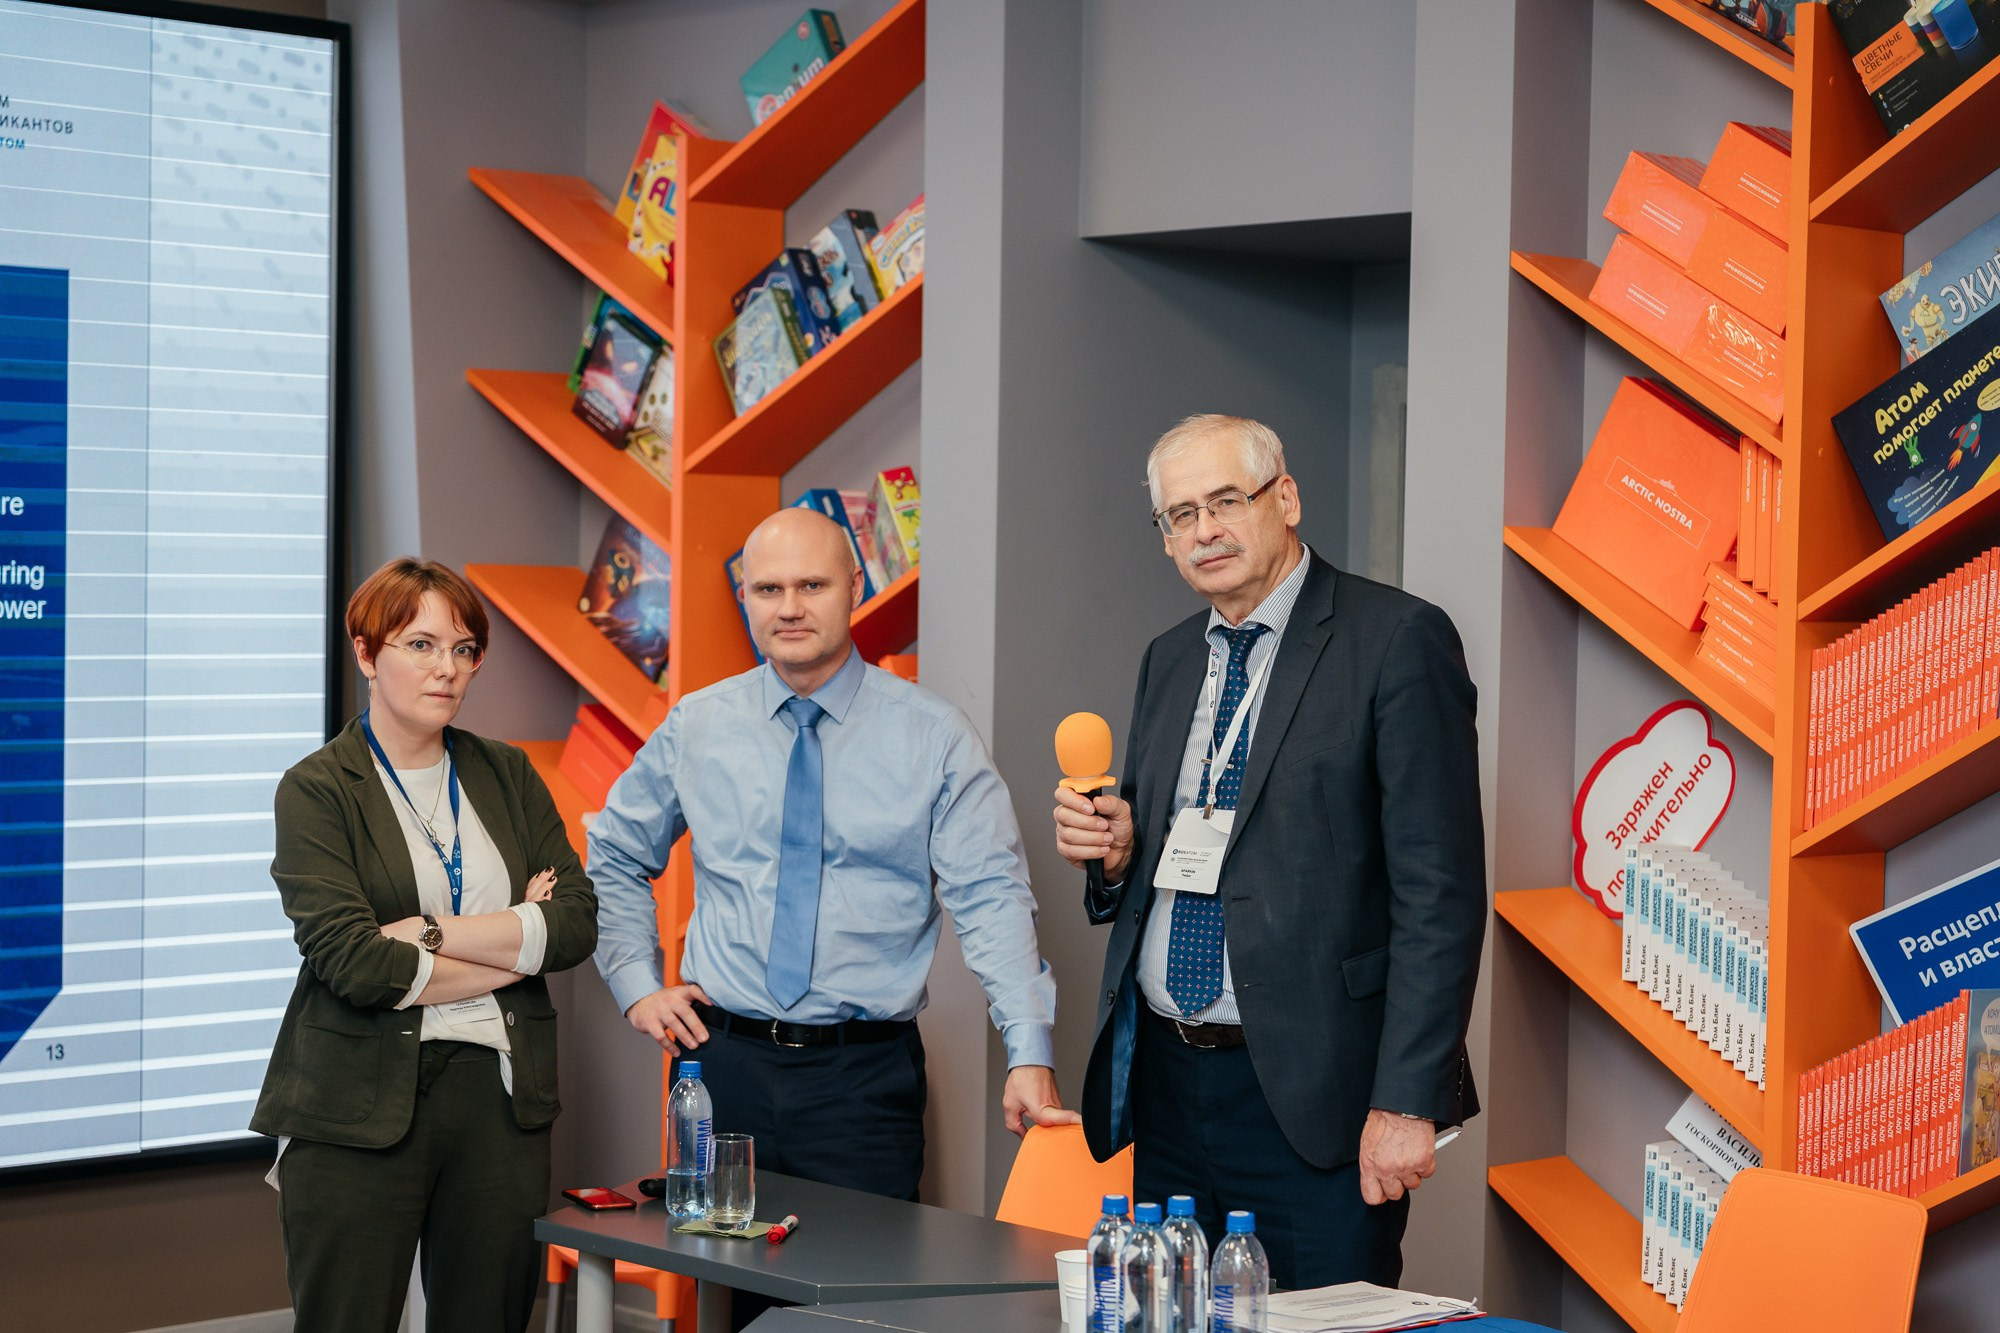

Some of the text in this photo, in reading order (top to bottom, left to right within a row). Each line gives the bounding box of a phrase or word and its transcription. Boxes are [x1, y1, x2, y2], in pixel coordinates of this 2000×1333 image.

[1861, 31, 1902, 66] ЦВЕТНЫЕ
[1865, 50, 1894, 74] СВЕЧИ
[1740, 176, 1780, 204] ПРОФЕССИОНАЛЫ
[1642, 204, 1682, 230] ПРОФЕССИОНАЛЫ
[1724, 262, 1765, 290] ПРОФЕССИОНАЛЫ
[1628, 287, 1667, 316] ПРОФЕССИОНАЛЫ
[1724, 349, 1764, 378] ПРОФЕССИОНАЛЫ
[1873, 398, 1943, 465] помогает
[1943, 346, 2000, 404] планете
[1874, 381, 1930, 435] Атом
[1621, 474, 1692, 530] ARCTIC NOSTRA
[0, 560, 45, 590] ring
[1988, 569, 1997, 616] АТОМЩИКОМ
[1962, 585, 1970, 630] АТОМЩИКОМ
[1605, 761, 1674, 850] Заряжен
[1607, 753, 1712, 897] пожительно
[1919, 967, 1938, 988] и
[46, 1044, 65, 1060] 13
[1942, 1026, 1950, 1072] АТОМЩИКОМ
[1957, 1013, 1966, 1058] АТОМЩИКОМ
[1717, 1128, 1763, 1168] ВАСИЛЬ
